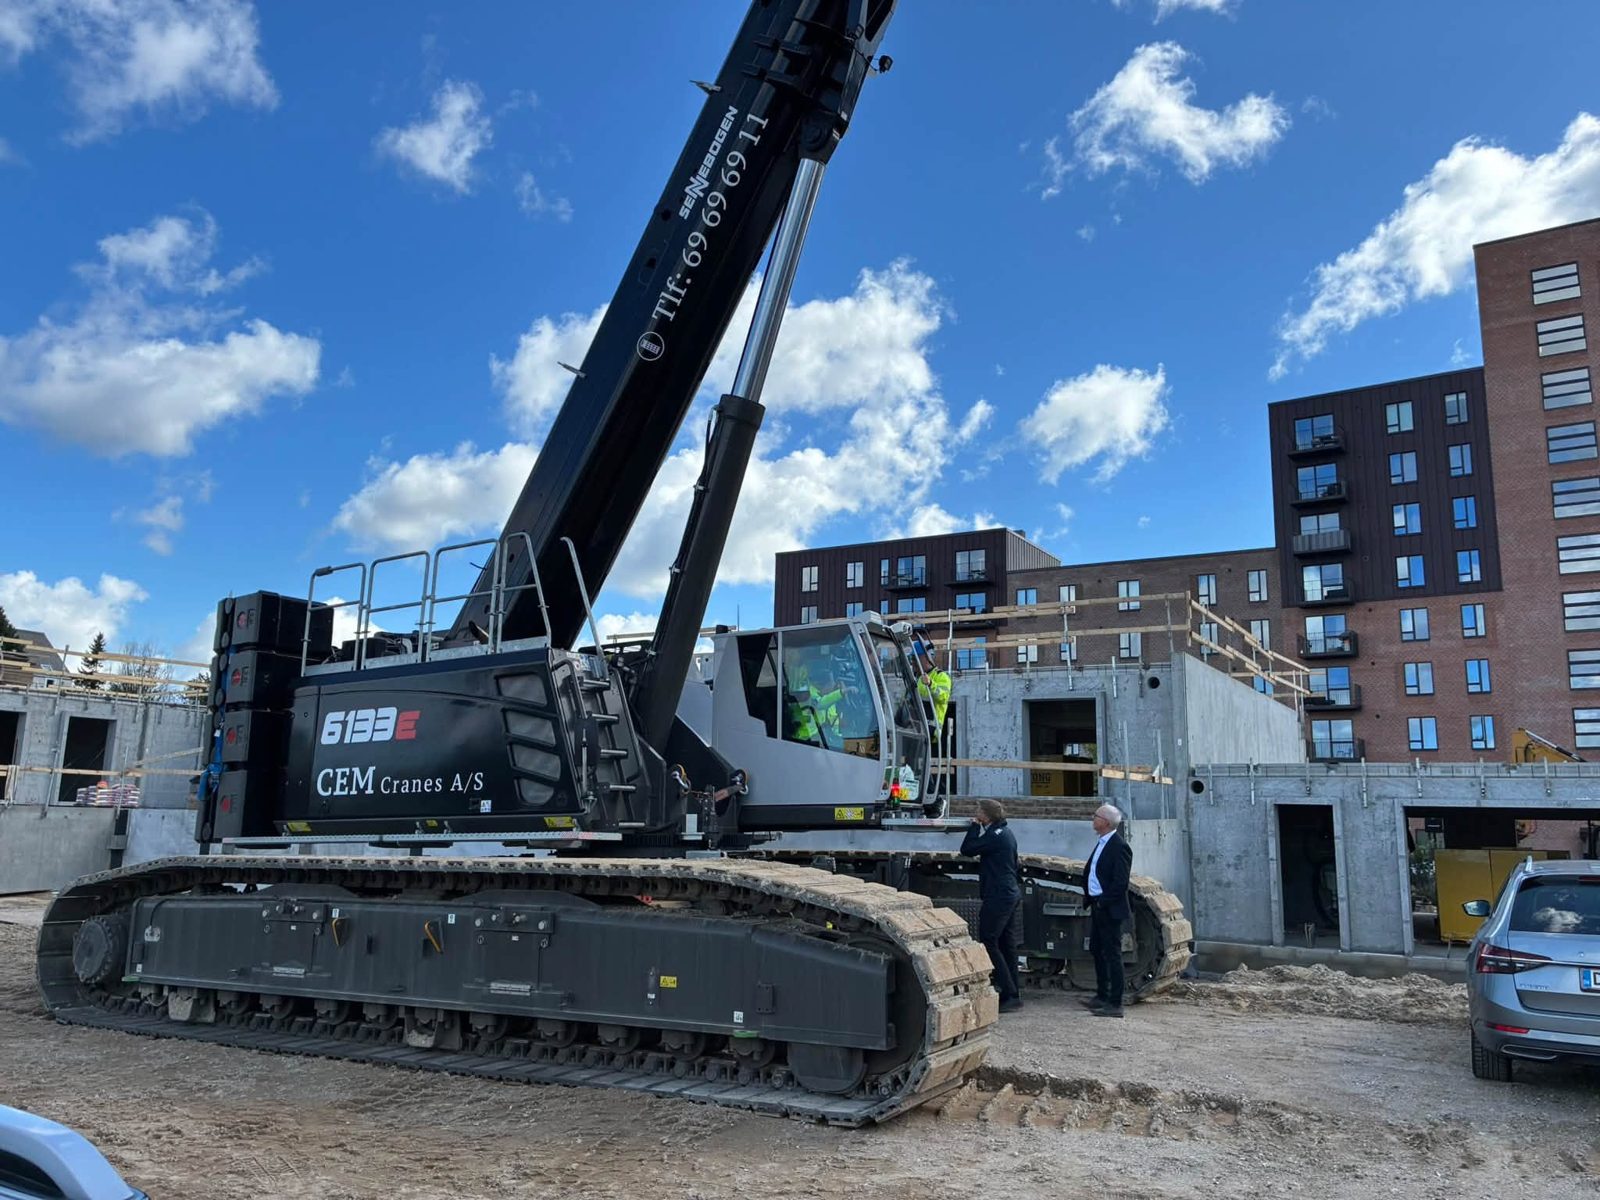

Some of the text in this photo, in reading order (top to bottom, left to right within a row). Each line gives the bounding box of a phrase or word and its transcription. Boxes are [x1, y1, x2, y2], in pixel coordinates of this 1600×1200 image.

[678, 105, 739, 220] SENNEBOGEN
[651, 112, 769, 322] Tlf: 69 69 69 11
[320, 706, 422, 745] 6133E
[316, 766, 484, 797] CEM Cranes A/S
